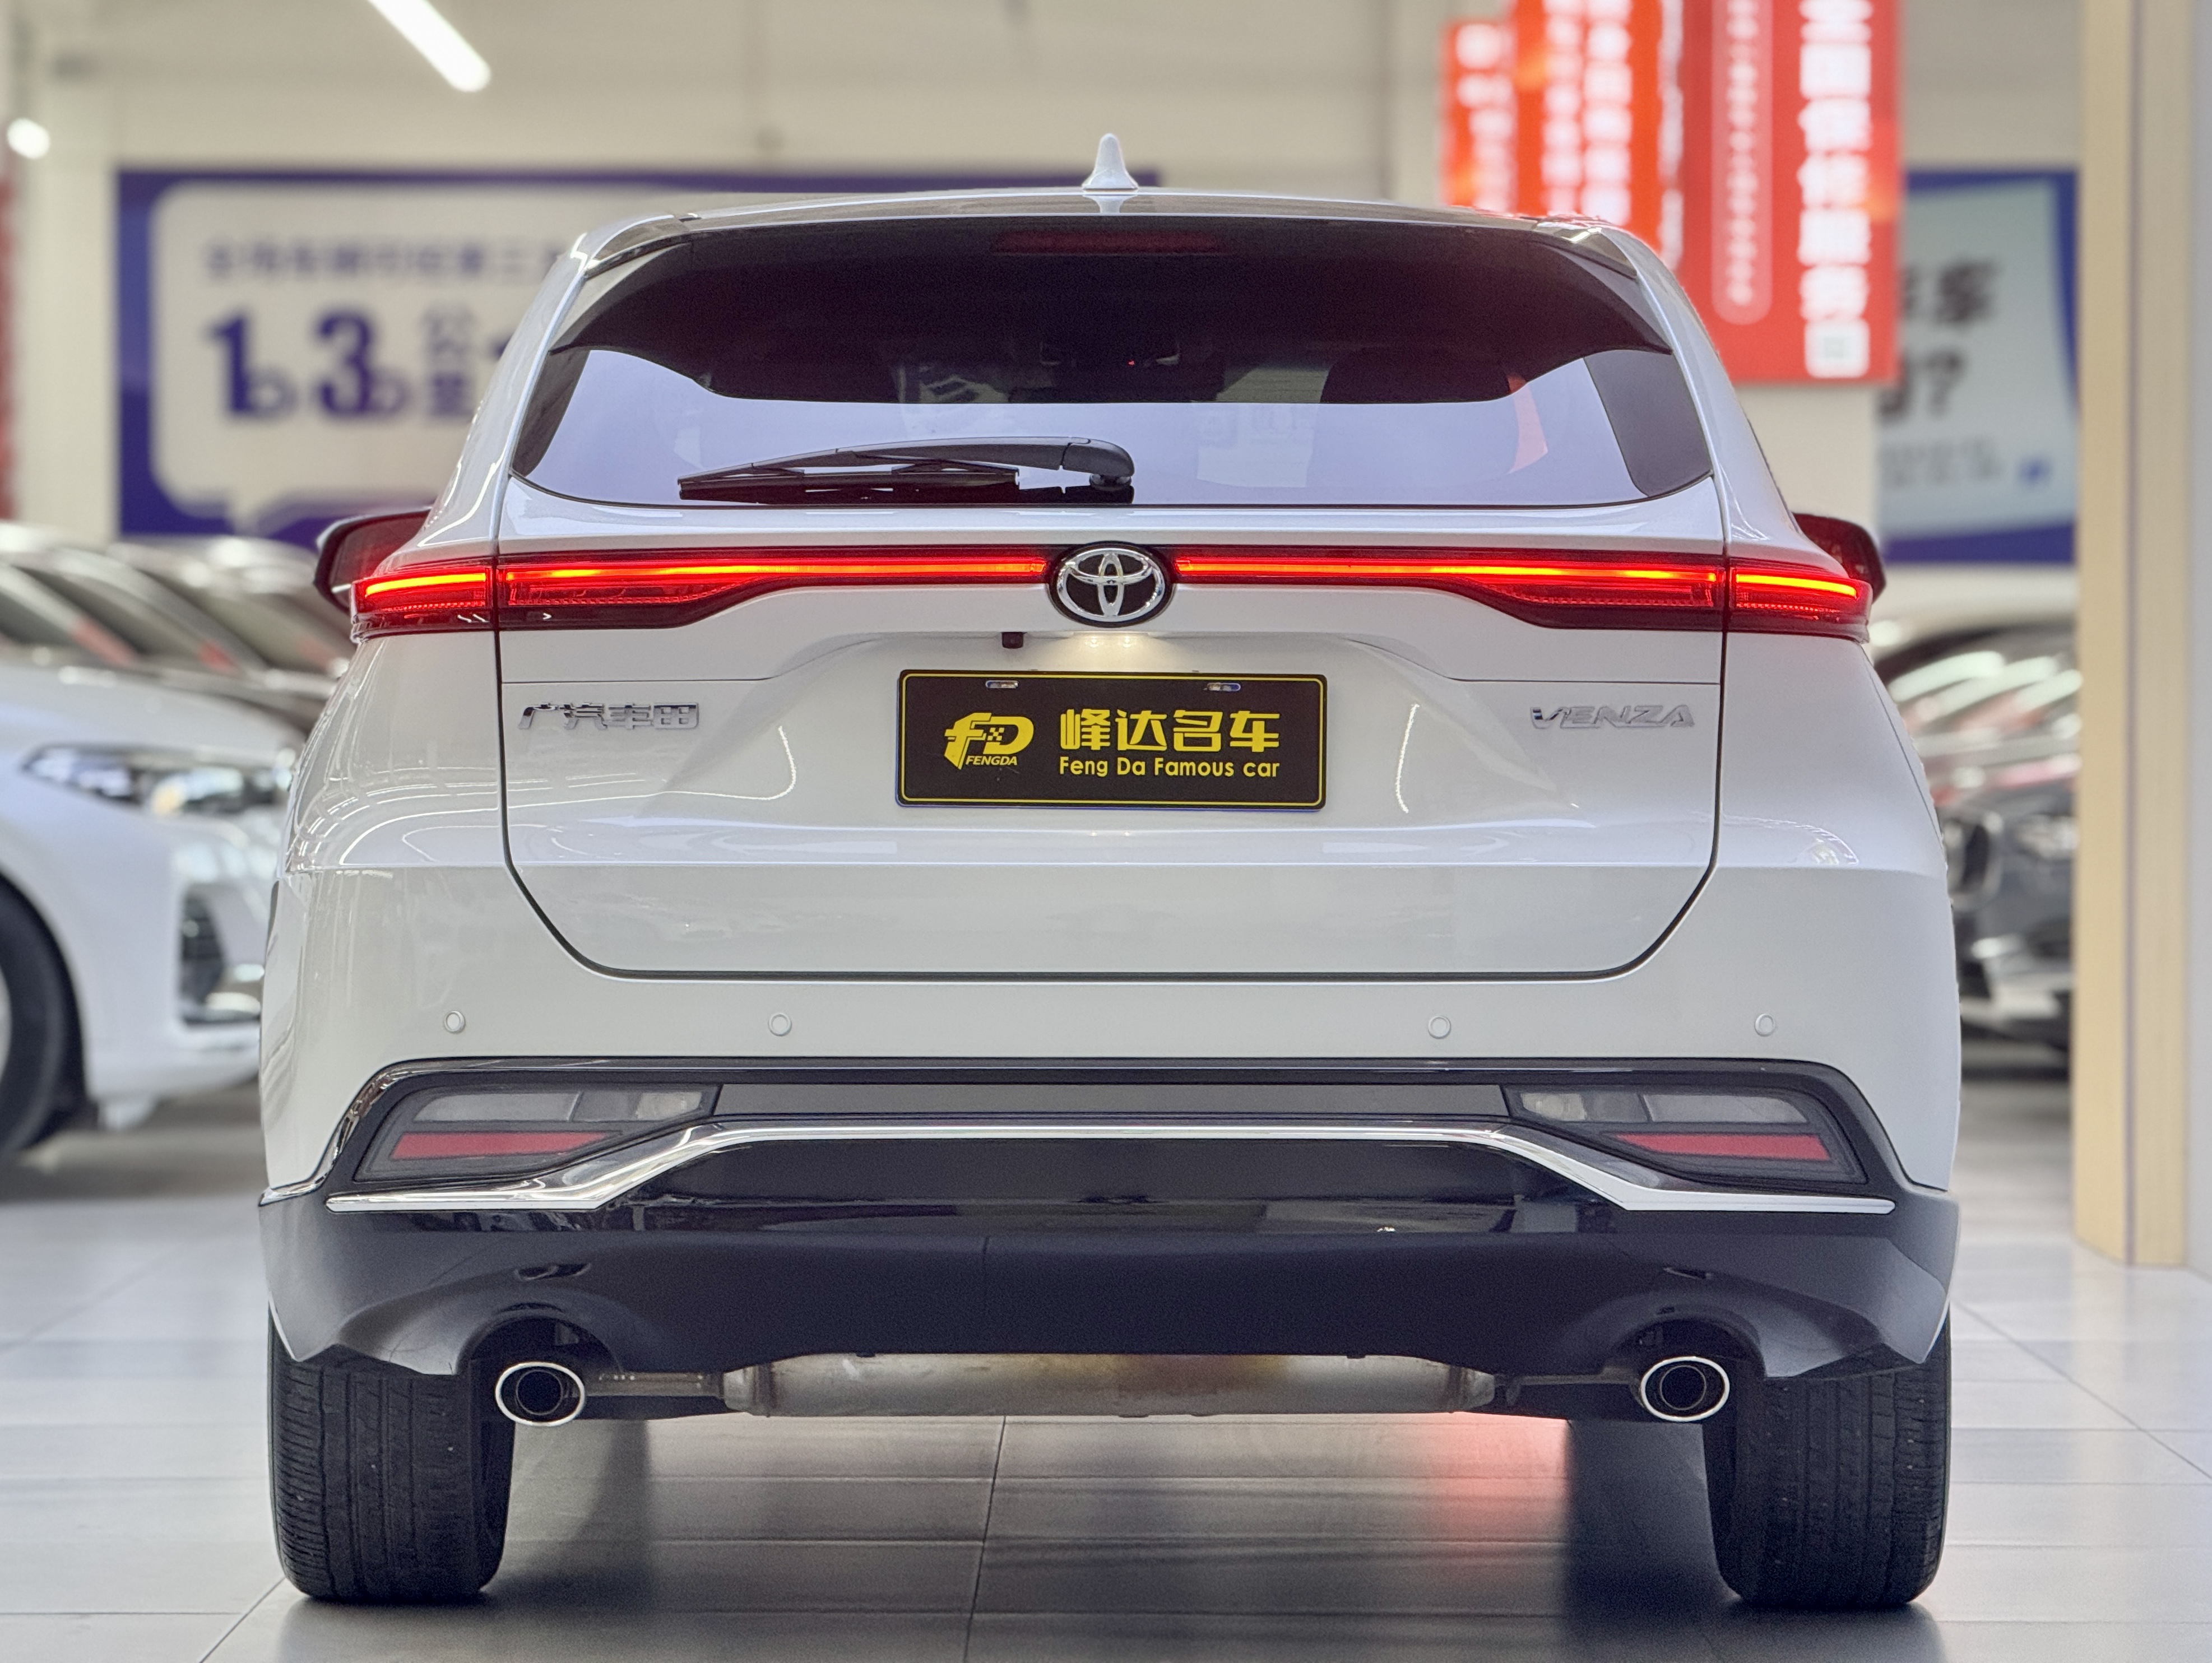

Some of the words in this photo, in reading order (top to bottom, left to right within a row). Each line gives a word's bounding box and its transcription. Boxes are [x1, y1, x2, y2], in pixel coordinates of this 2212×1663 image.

[1530, 704, 1695, 728] VENZA
[1061, 709, 1279, 752] 峰达名车
[966, 756, 1017, 765] FENGDA
[1060, 756, 1107, 777] Feng
[1117, 758, 1145, 775] Da
[1155, 758, 1234, 777] Famous
[1244, 763, 1279, 777] car
